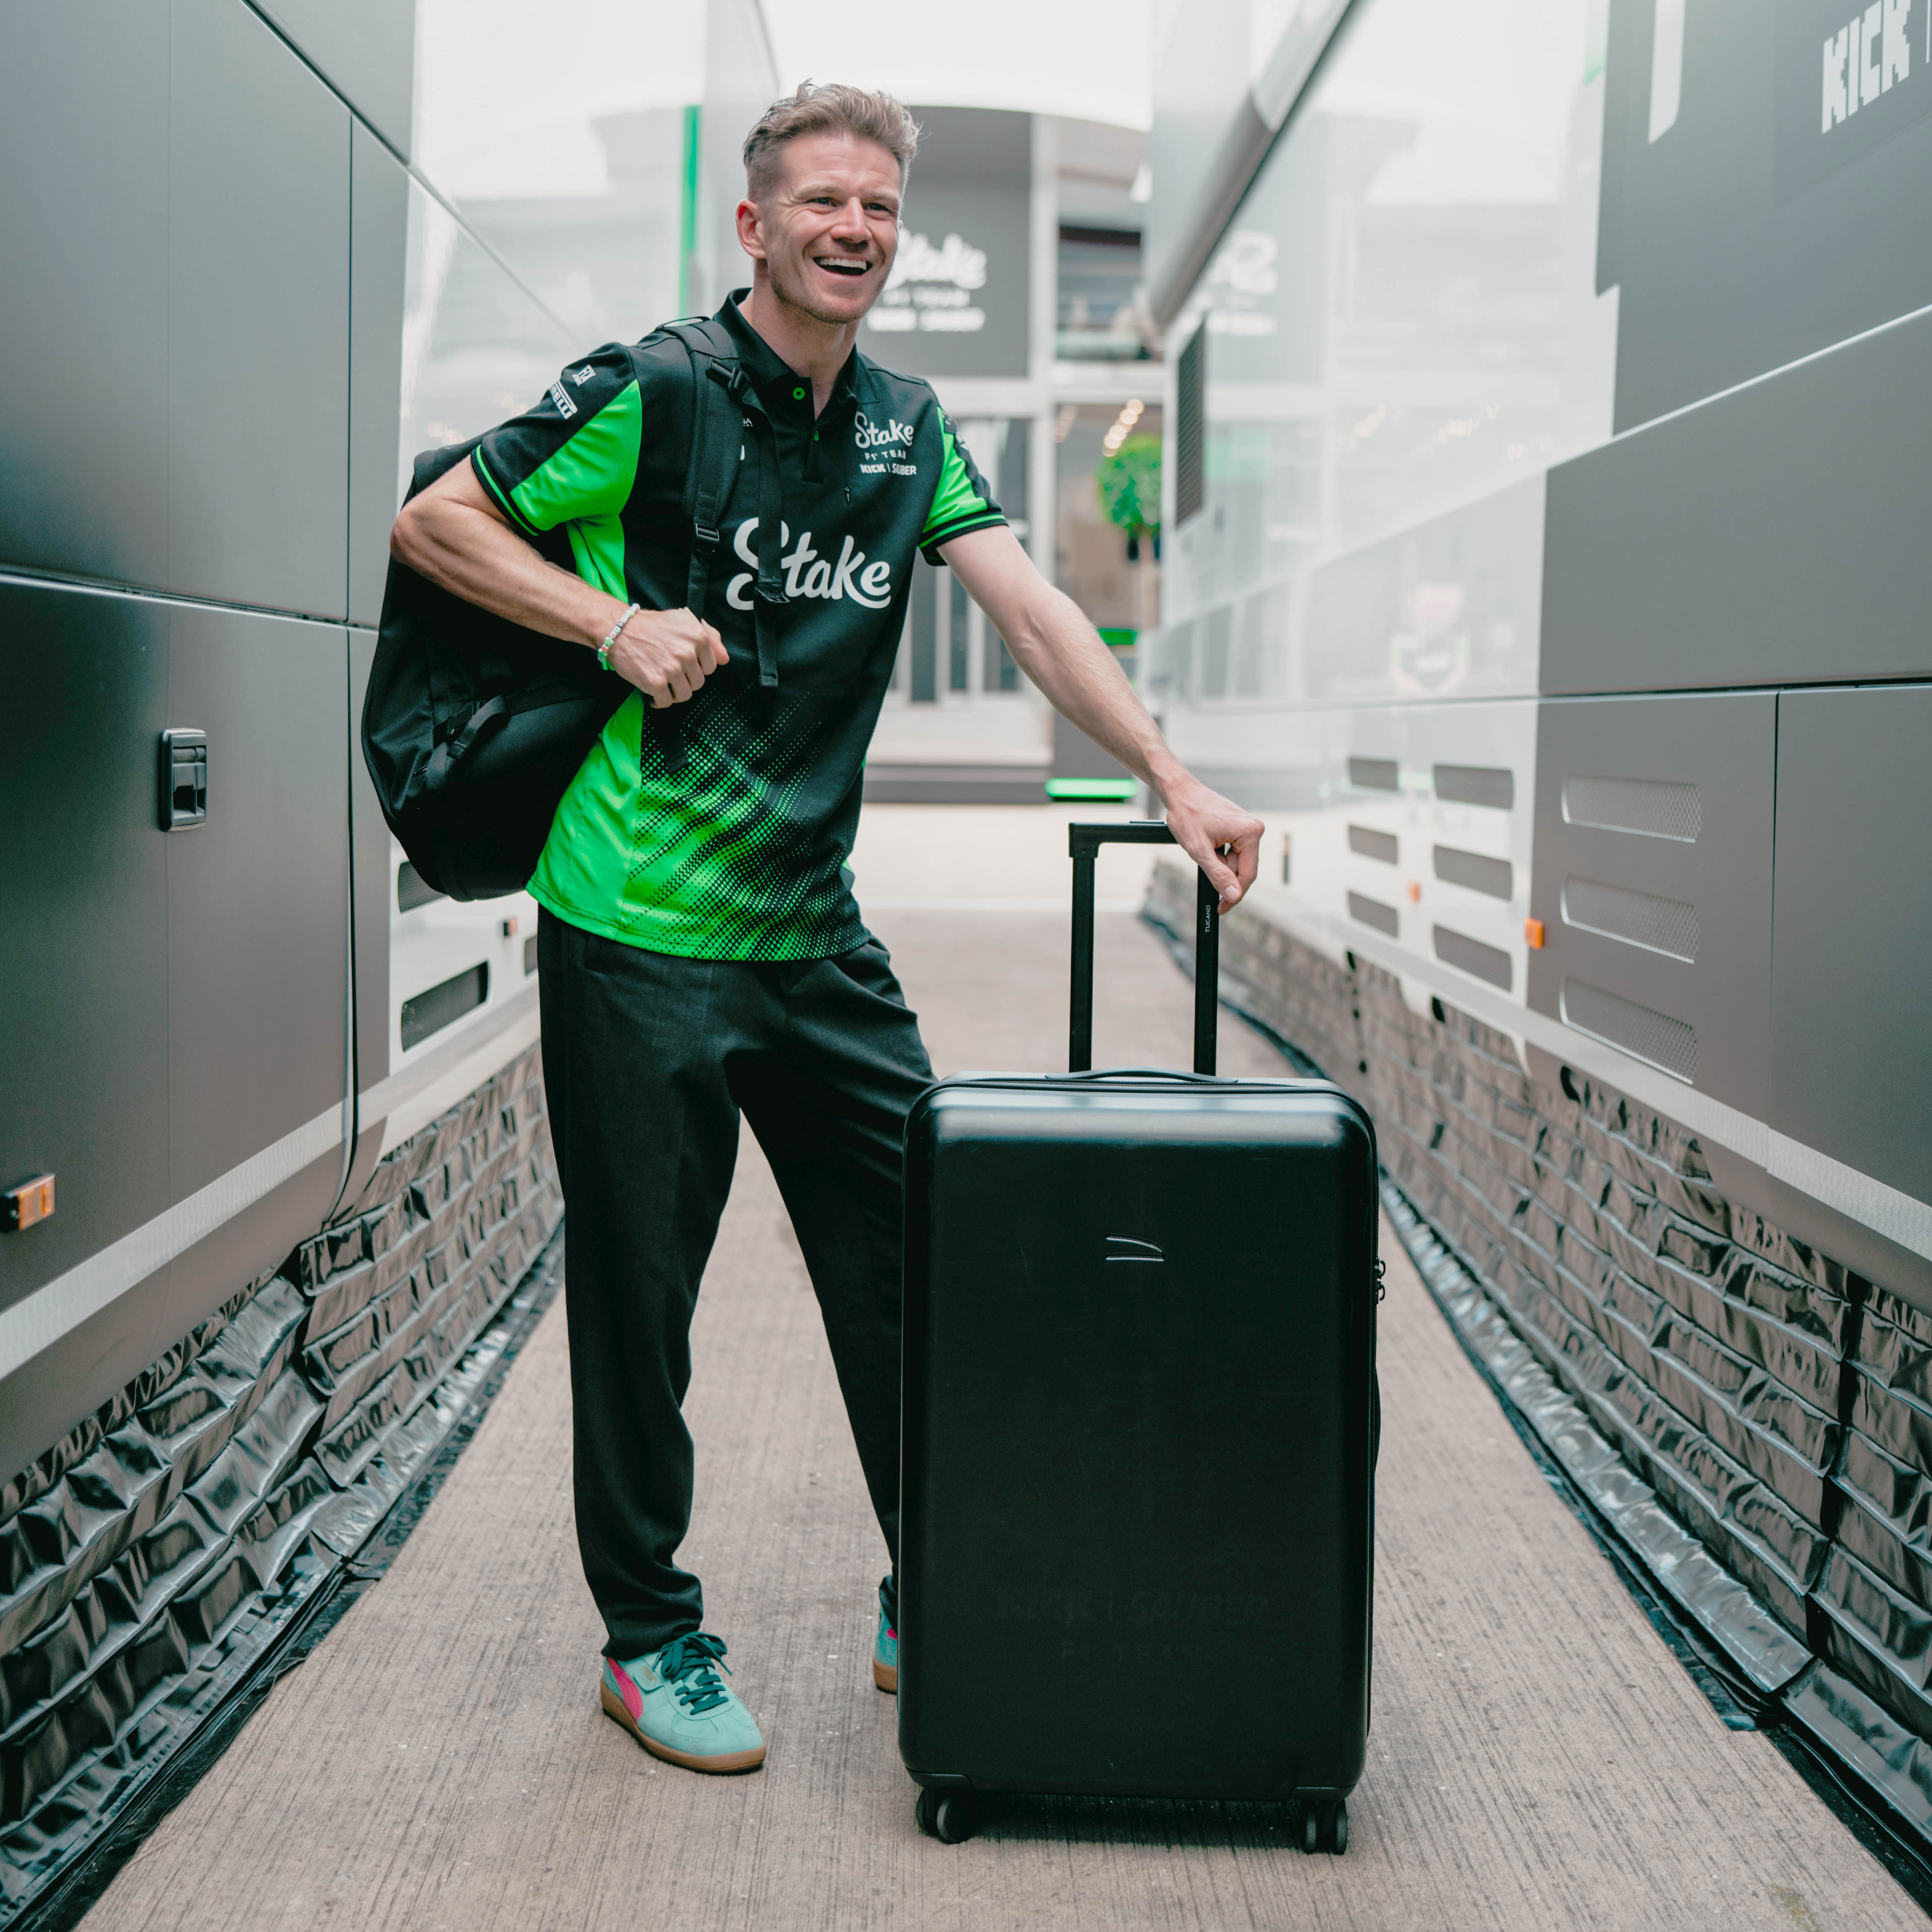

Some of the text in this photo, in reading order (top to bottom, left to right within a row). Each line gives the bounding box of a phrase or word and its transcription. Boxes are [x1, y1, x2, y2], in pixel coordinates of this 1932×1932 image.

[1821, 0, 1911, 134] KICK
[854, 411, 914, 448] Stake
[881, 449, 906, 459] TEAM
[860, 463, 916, 476] KICK SAUBER
